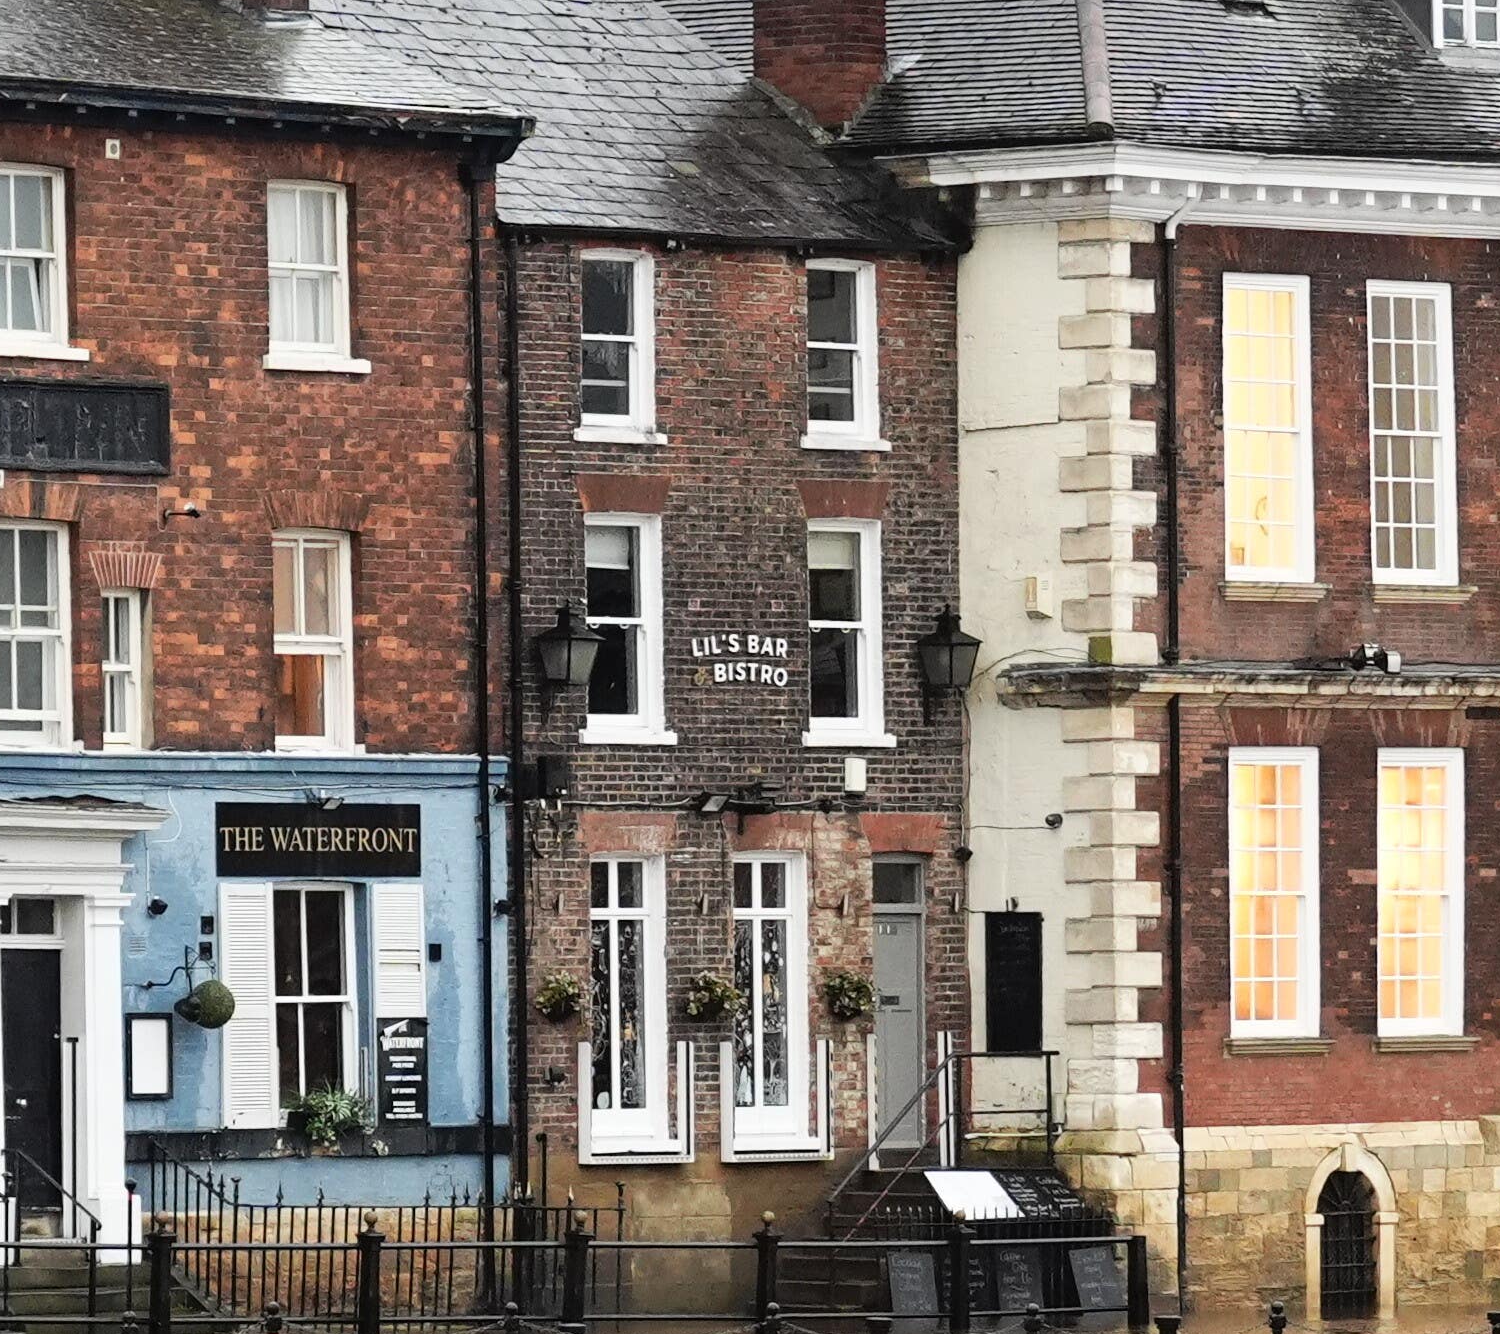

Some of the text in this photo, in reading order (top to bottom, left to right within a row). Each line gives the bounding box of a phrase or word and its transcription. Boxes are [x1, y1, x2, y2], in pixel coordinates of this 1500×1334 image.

[691, 633, 789, 659] LIL'S BAR
[713, 661, 789, 687] BISTRO
[219, 826, 418, 853] THE WATERFRONT
